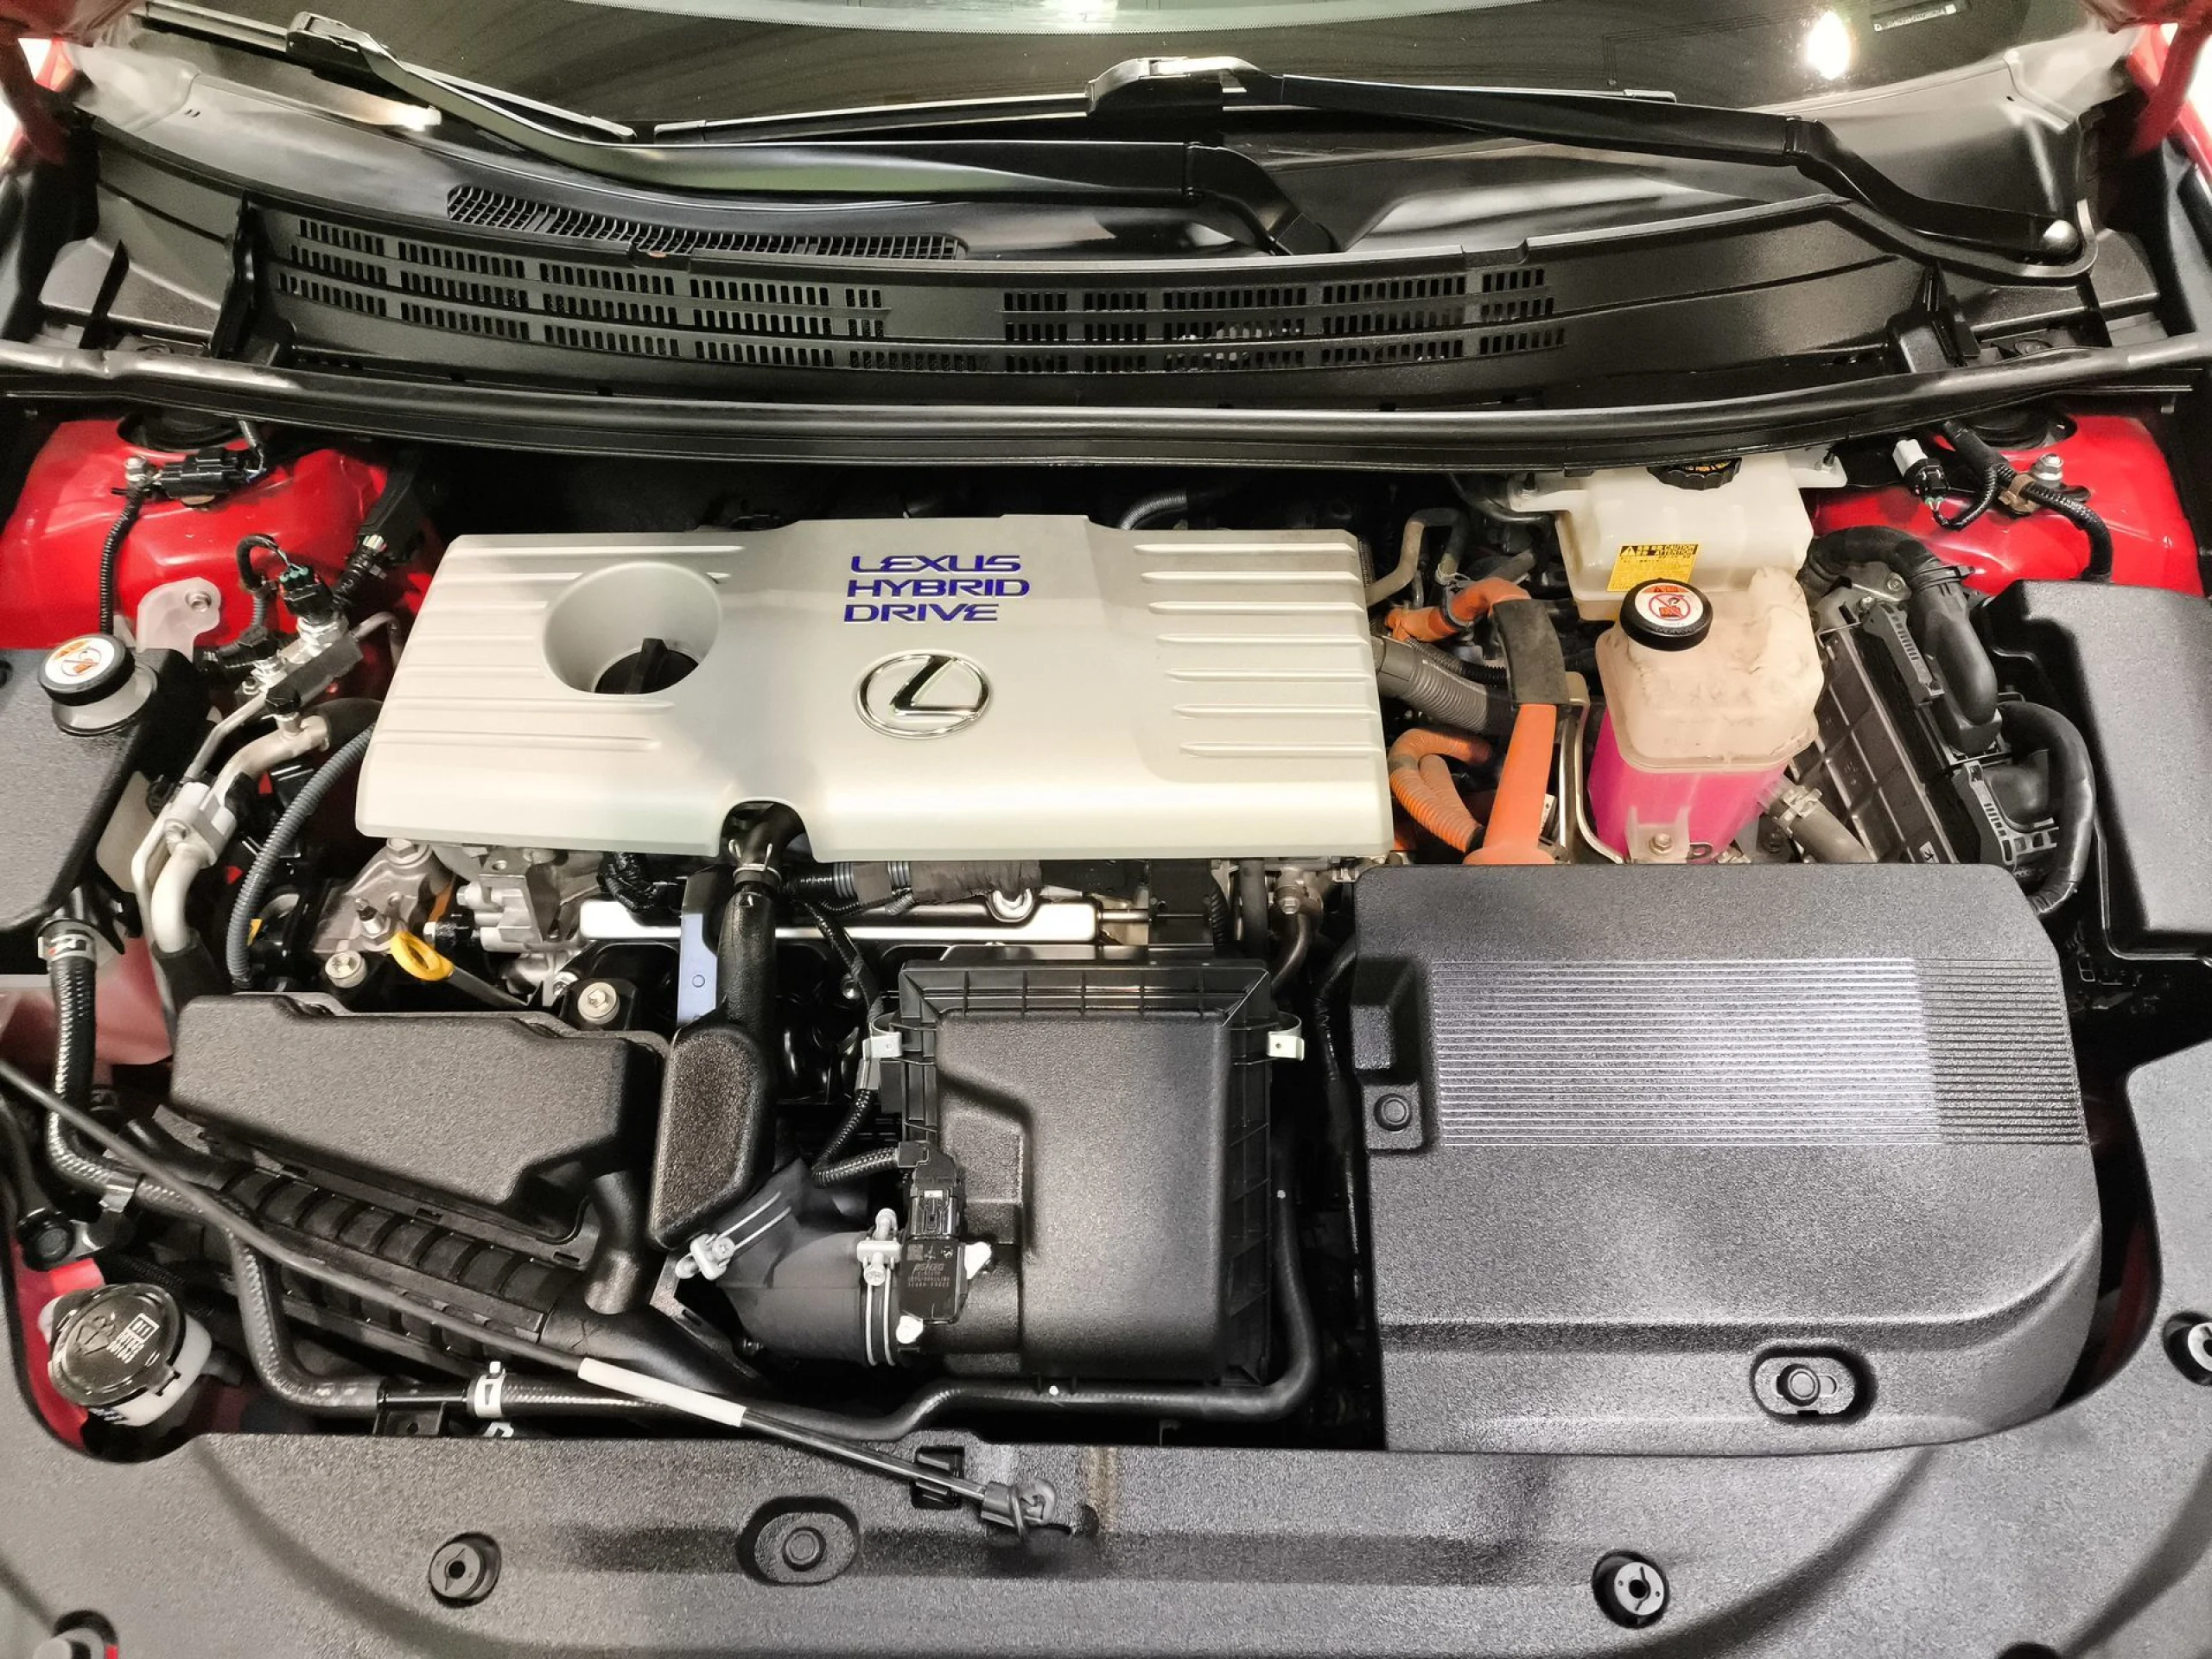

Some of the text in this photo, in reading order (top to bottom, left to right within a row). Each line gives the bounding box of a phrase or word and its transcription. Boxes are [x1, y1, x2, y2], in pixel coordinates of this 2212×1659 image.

[850, 555, 1021, 573] LEXUS
[847, 579, 1031, 597] HYBRID
[844, 603, 999, 622] DRIVE
